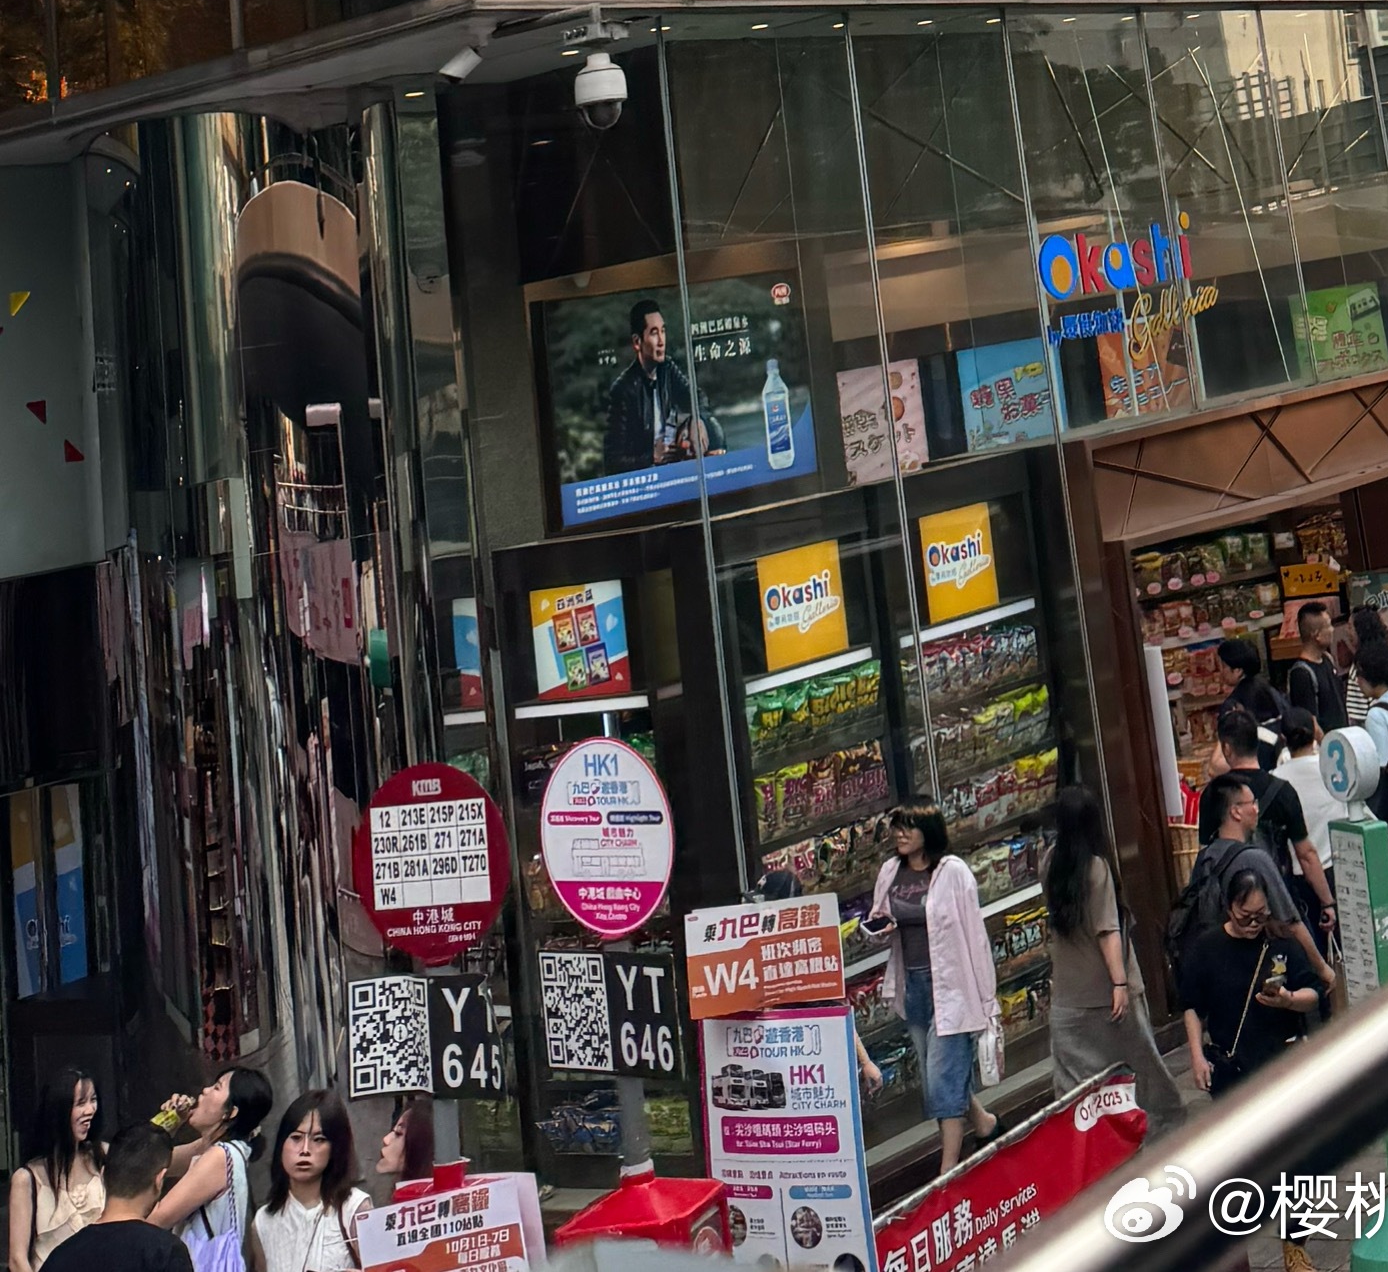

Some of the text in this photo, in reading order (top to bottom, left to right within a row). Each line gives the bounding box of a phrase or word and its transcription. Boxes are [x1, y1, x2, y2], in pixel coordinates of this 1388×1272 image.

[1039, 211, 1193, 301] Okashi
[929, 532, 981, 567] Okashi
[766, 571, 829, 612] Okashi
[584, 753, 619, 777] HK1
[1327, 739, 1349, 793] 3
[412, 778, 442, 797] KMB
[572, 783, 628, 795] 九巴 遊香港
[596, 796, 630, 806] TOUR HK
[379, 802, 484, 829] 12 213E 215P 215X
[374, 828, 486, 854] 230R 261B 271 271A
[601, 838, 614, 847] CITY
[375, 853, 487, 880] 271B 281A 296D T270
[380, 887, 397, 906] W4
[578, 886, 605, 900] 中港城
[412, 907, 455, 926] 中港城
[581, 902, 597, 911] China
[629, 902, 641, 913] City
[387, 926, 412, 938] CHINA
[413, 924, 437, 937] HONG
[438, 922, 462, 934] KONG
[463, 920, 482, 931] CITY
[703, 903, 821, 943] 乘九巴轉高鐵
[615, 964, 665, 1014] YT
[703, 958, 759, 997] W4
[620, 1021, 675, 1072] 646
[733, 1026, 804, 1044] 九巴 遊香港
[760, 1046, 788, 1058] TOUR
[790, 1045, 804, 1057] HK
[442, 1043, 501, 1089] 645
[789, 1064, 826, 1086] HK1
[791, 1085, 835, 1100] 城市魅力
[792, 1099, 847, 1110] CITY CHARM
[783, 1122, 837, 1137] 尖沙咀码头
[759, 1140, 771, 1148] Sha
[385, 1187, 489, 1231] 乘九巴轉高鐵
[975, 1207, 999, 1235] Daily
[999, 1182, 1037, 1224] Services
[445, 1228, 510, 1255] 10月1日-7日
